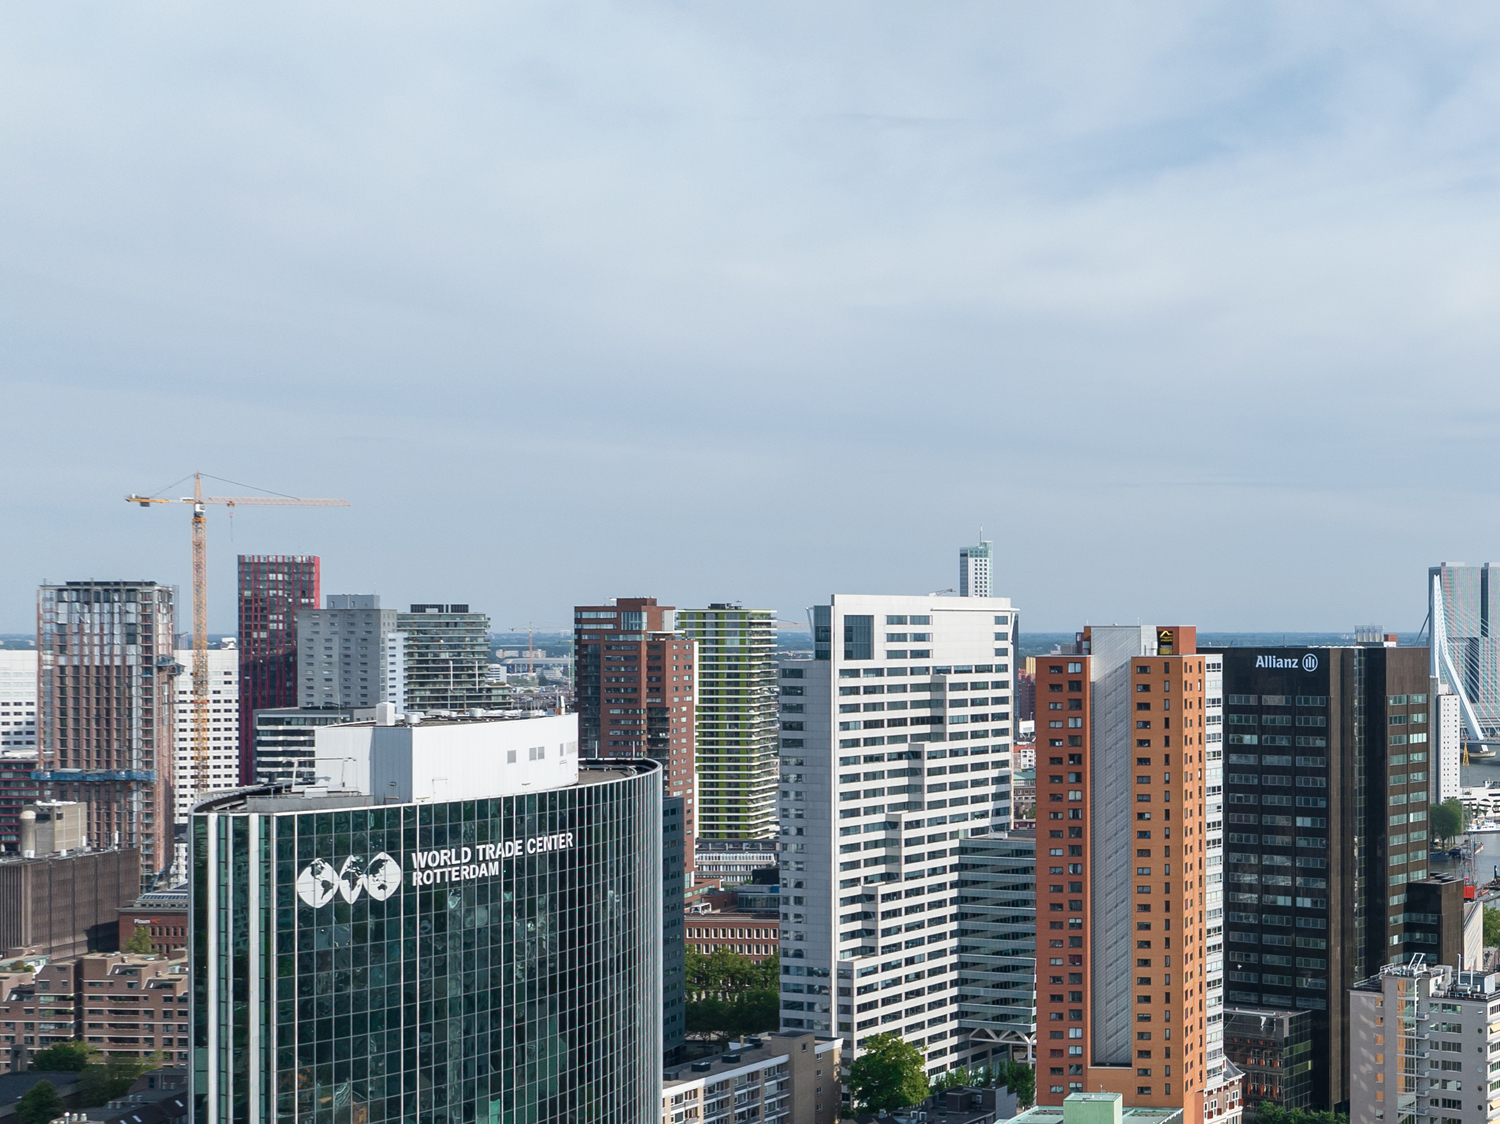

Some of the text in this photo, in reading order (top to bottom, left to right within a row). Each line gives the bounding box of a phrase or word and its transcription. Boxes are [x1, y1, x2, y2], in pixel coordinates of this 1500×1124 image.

[1255, 655, 1299, 668] Allianz
[411, 832, 574, 869] WORLD TRADE CENTER
[412, 861, 500, 886] ROTTERDAM
